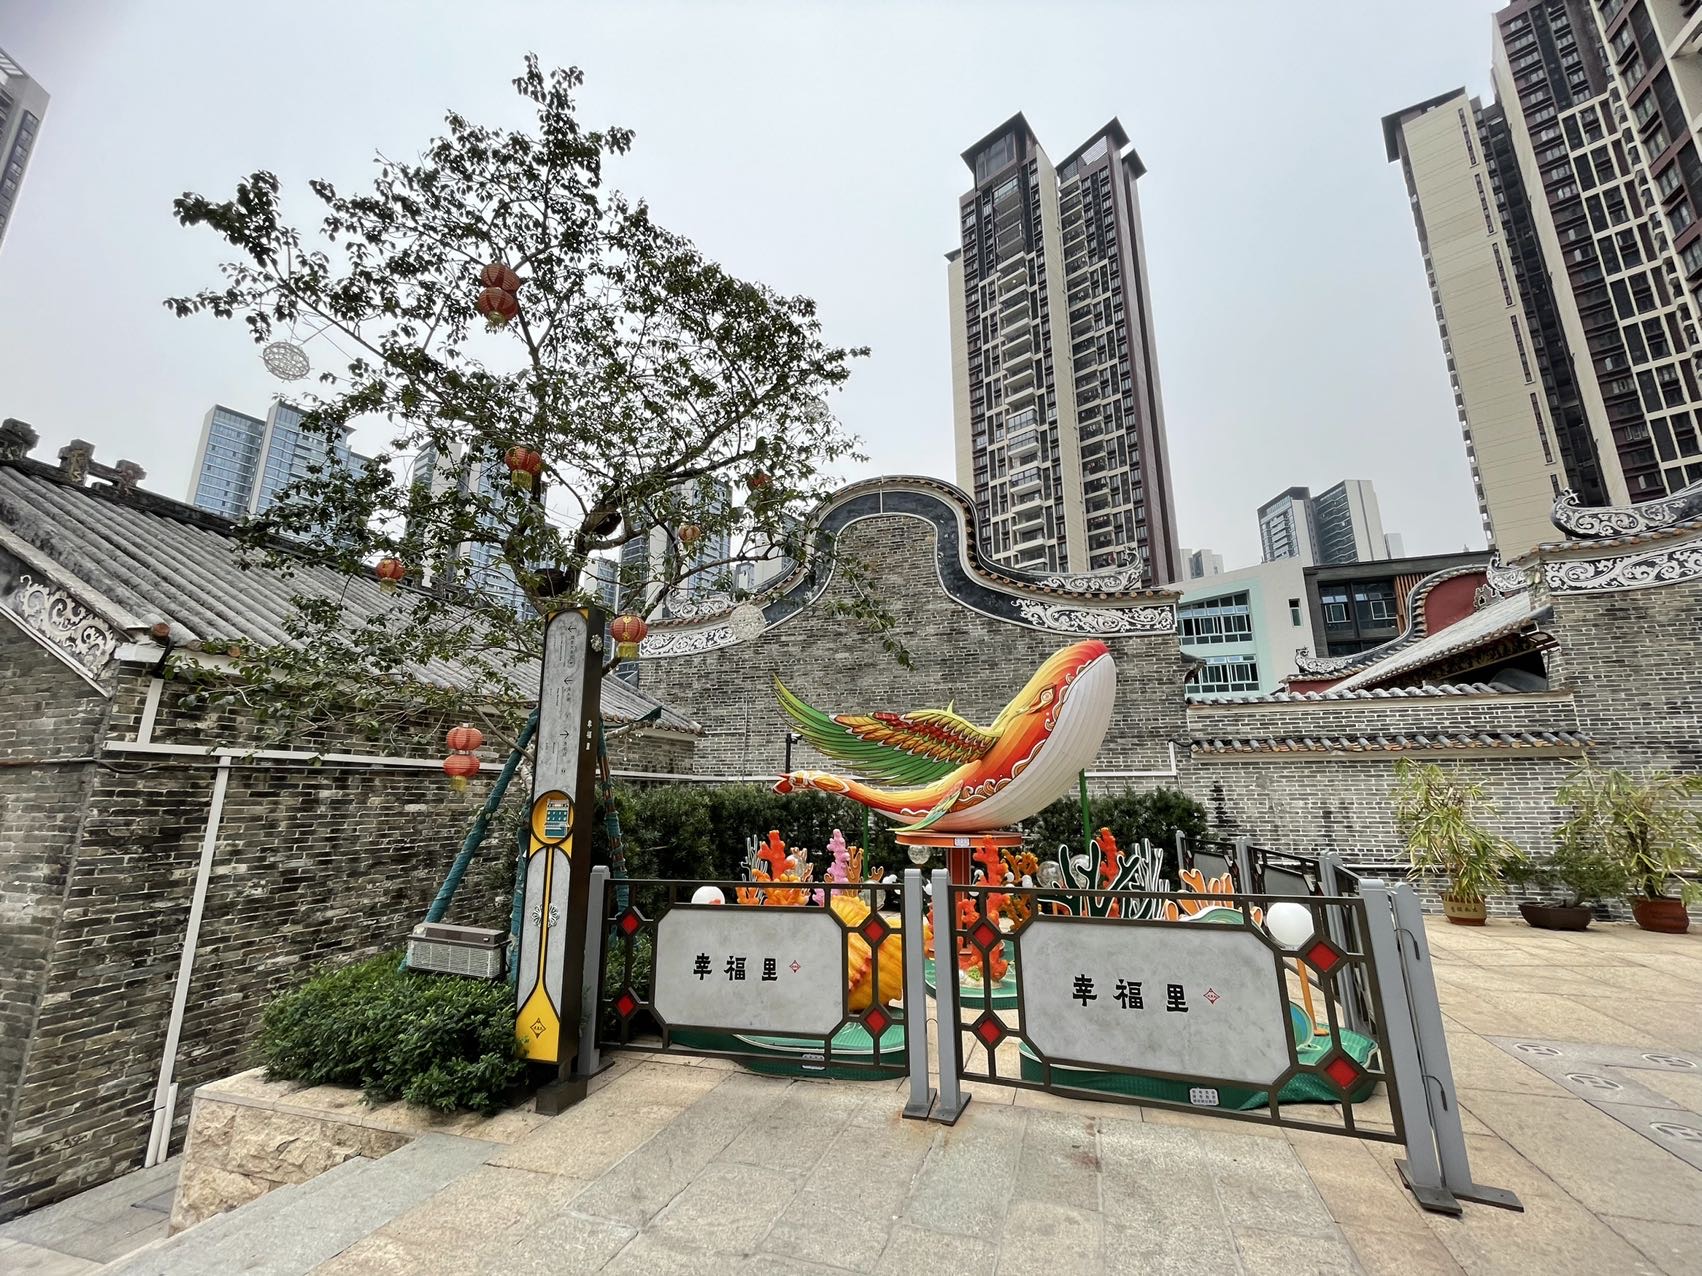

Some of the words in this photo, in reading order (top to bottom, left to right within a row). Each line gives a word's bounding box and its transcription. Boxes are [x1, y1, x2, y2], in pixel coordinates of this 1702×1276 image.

[692, 952, 778, 982] 幸福里
[1072, 973, 1189, 1013] 幸福里
